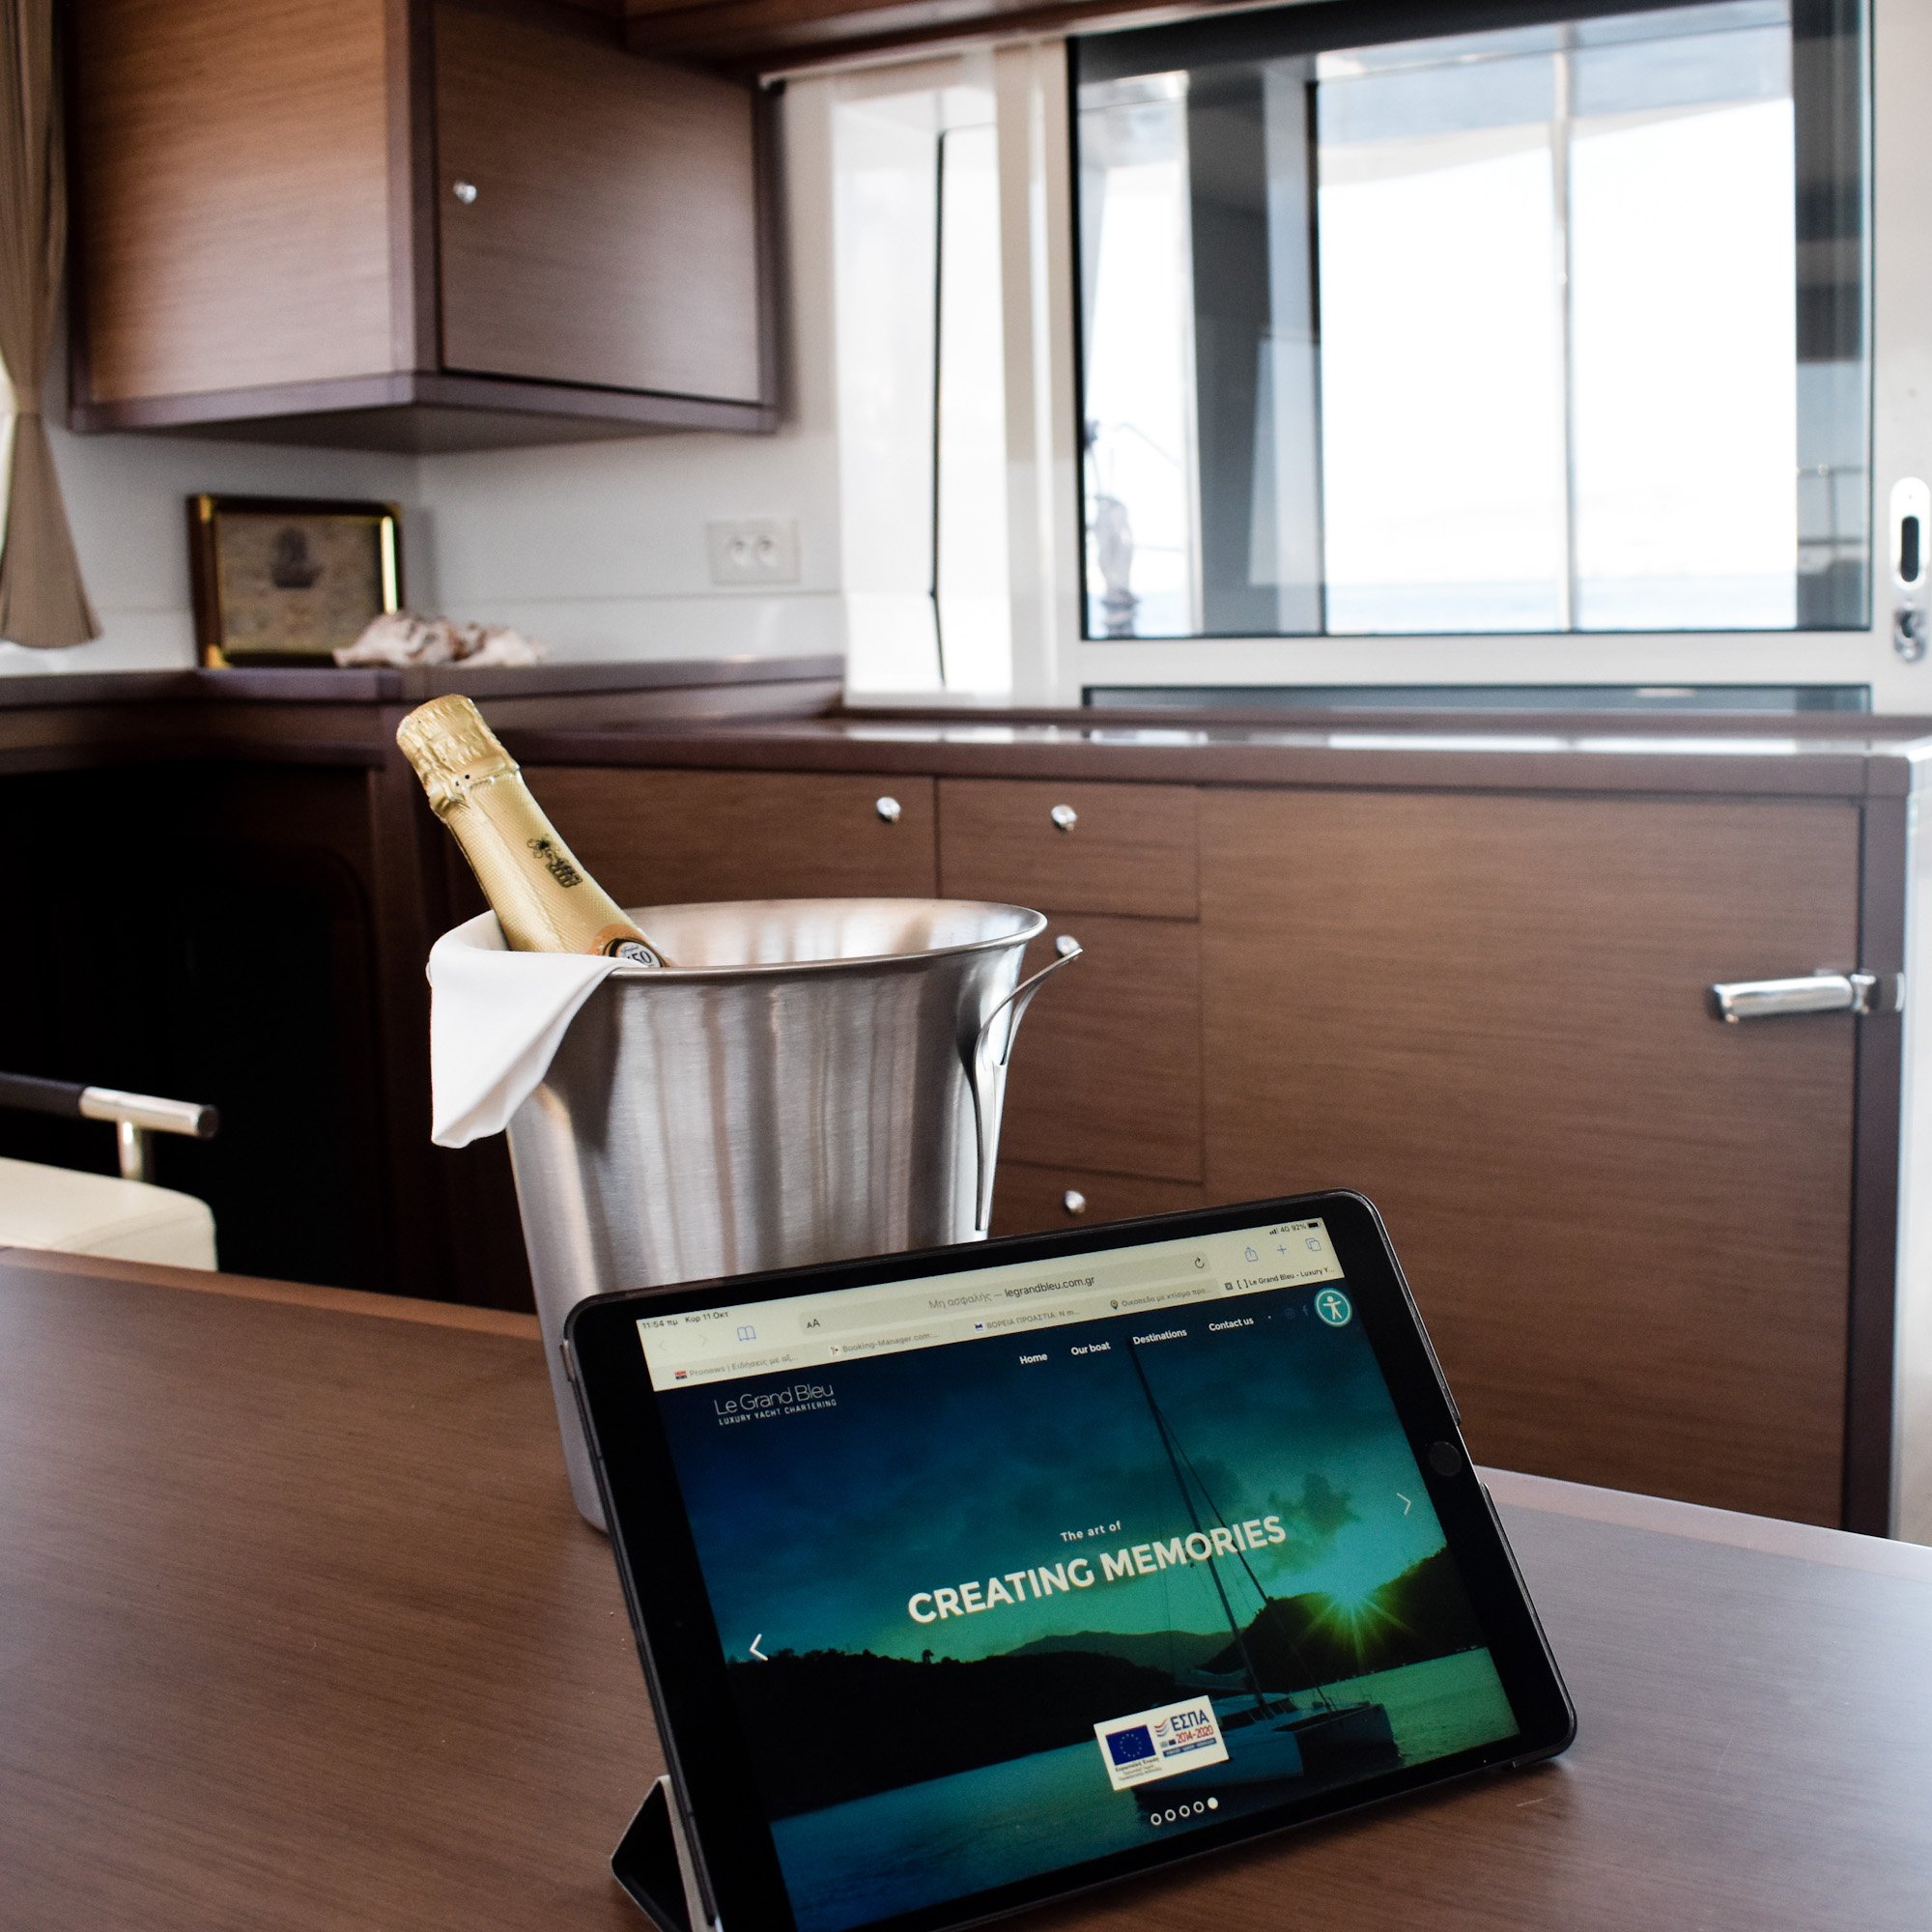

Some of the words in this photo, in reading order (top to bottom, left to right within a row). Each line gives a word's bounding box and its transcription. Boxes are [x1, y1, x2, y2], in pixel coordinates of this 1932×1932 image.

[1258, 1275, 1279, 1285] Grand
[1279, 1272, 1294, 1281] Bleu
[1300, 1268, 1322, 1278] Luxury
[1005, 1276, 1094, 1298] legrandbleu.com.gr
[642, 1320, 665, 1329] 11:54
[1208, 1318, 1241, 1331] Contact
[1242, 1317, 1254, 1326] us
[1133, 1328, 1187, 1346] Destinations
[1070, 1345, 1088, 1355] Our
[1089, 1341, 1111, 1352] boat
[1019, 1352, 1048, 1365] Home
[714, 1399, 738, 1415] Le
[739, 1386, 793, 1410] Grand
[794, 1383, 835, 1402] Bleu
[718, 1413, 751, 1426] LUXURY
[754, 1407, 781, 1419] YACHT
[784, 1398, 837, 1414] CHARTERING
[1060, 1530, 1084, 1543] The
[1088, 1524, 1106, 1538] art
[1109, 1520, 1122, 1533] of
[908, 1557, 1095, 1624] CREATING
[1099, 1515, 1287, 1581] MEMORIES
[1170, 1709, 1210, 1732] ΕΣΠΑ
[1176, 1725, 1214, 1745] 2014-2020
